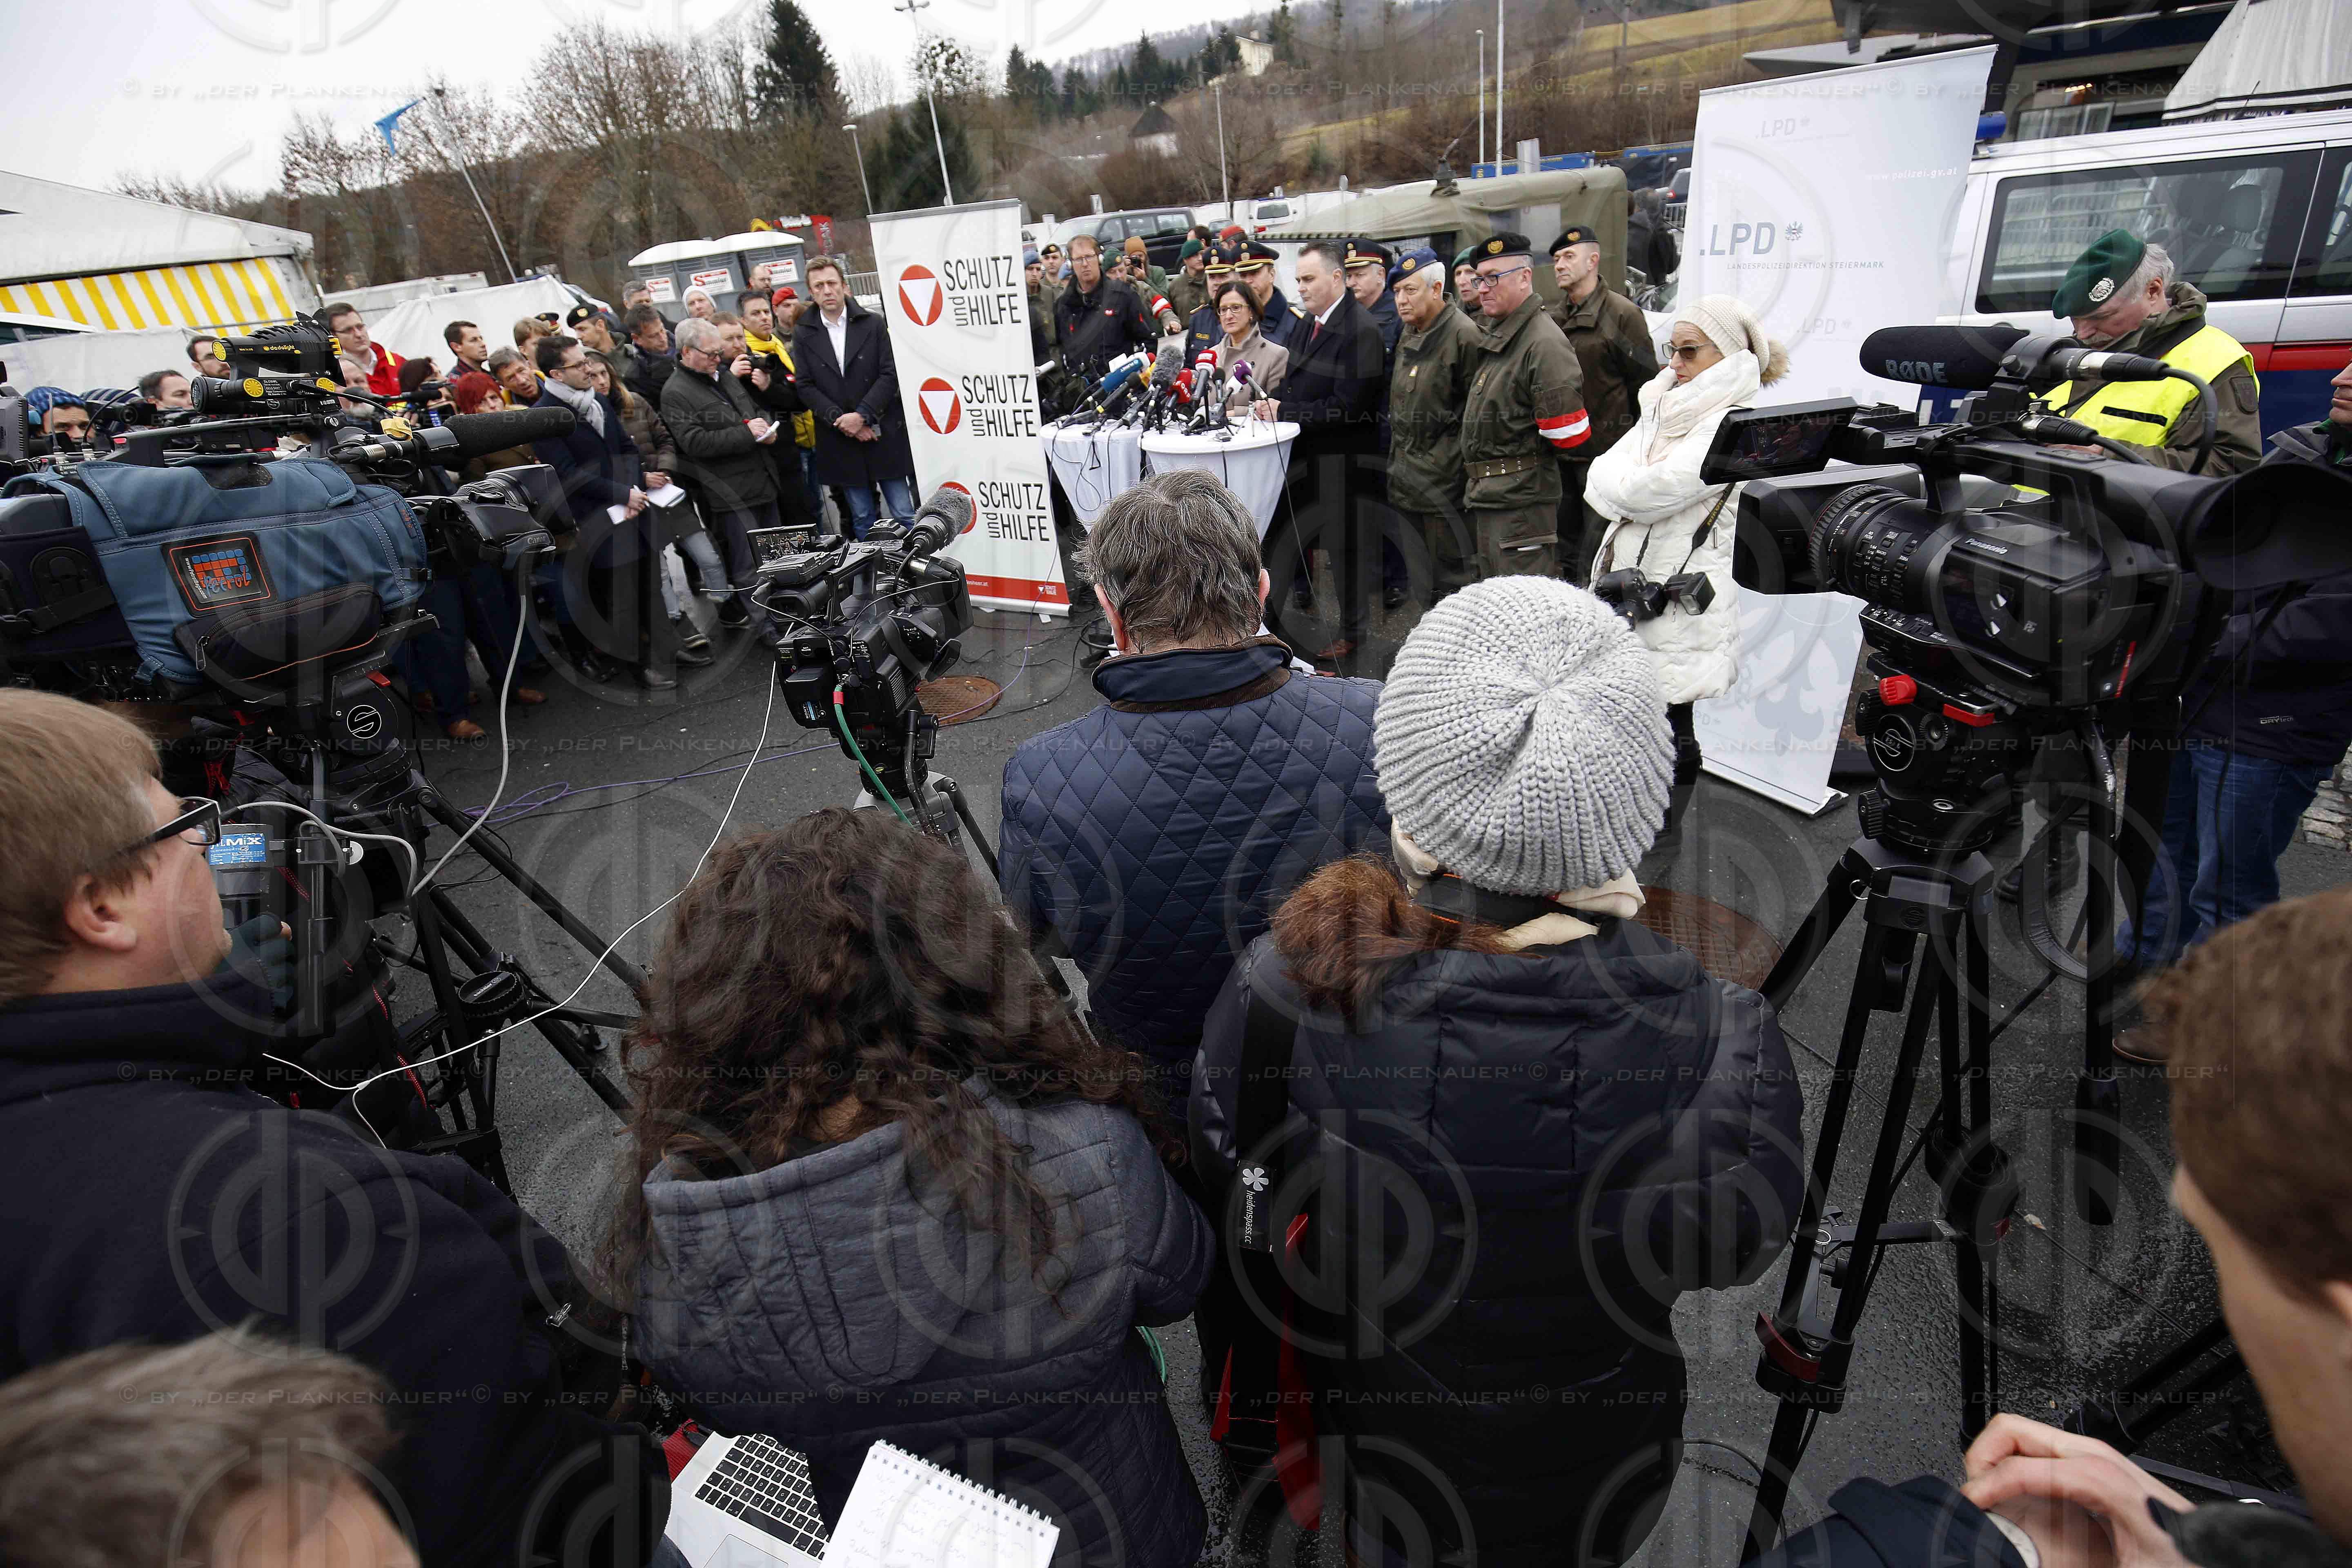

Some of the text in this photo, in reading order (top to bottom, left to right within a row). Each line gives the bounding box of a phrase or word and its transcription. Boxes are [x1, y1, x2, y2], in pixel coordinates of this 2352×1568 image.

[944, 255, 1017, 291] SCHUTZ
[1727, 261, 1885, 270] LANDESPOLIZEIDIREKTION STEIERMARK
[948, 296, 969, 326] und
[967, 292, 1022, 326] HILFE
[1884, 359, 1949, 384] RØDE
[962, 374, 1033, 404] SCHUTZ
[966, 409, 986, 437] und
[985, 409, 1038, 437] HILFE
[978, 481, 1046, 510] SCHUTZ
[982, 512, 1000, 539] und
[999, 512, 1050, 542] HILFE
[1964, 538, 2008, 555] Panasonic
[1243, 1190, 1256, 1244] heidenspass.cc
